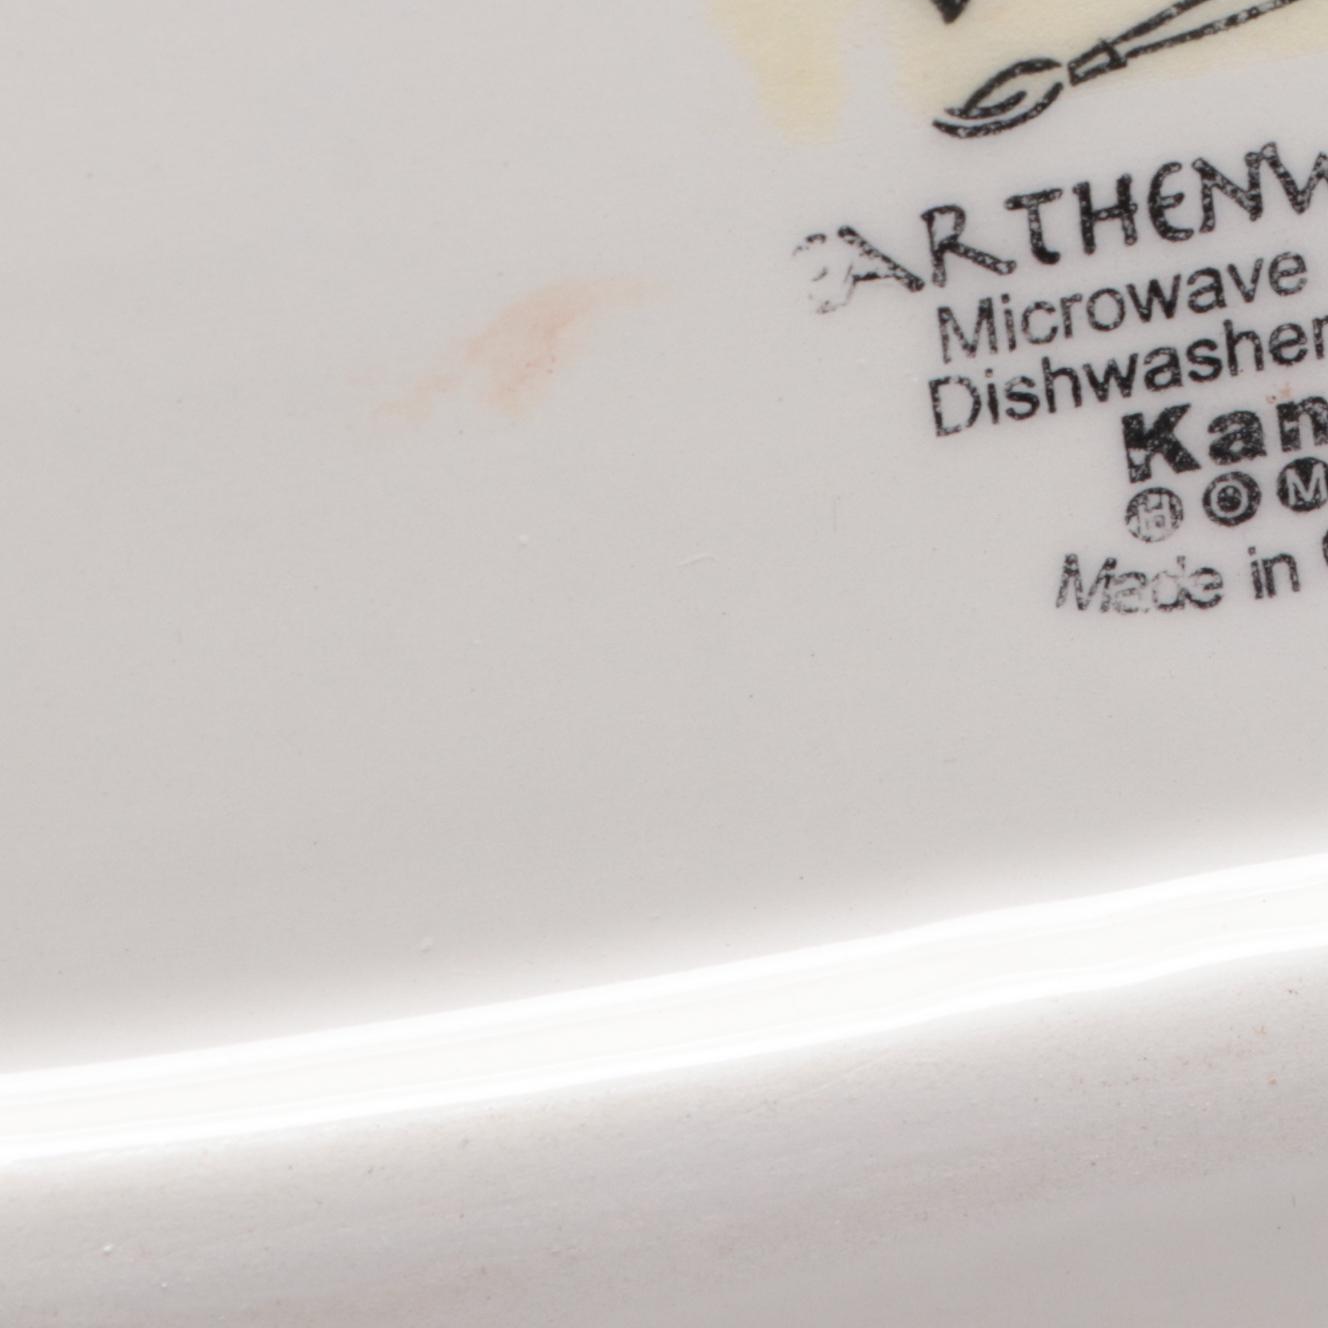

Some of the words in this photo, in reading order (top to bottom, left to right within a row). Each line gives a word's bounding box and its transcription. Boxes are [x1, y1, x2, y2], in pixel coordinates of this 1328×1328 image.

[936, 246, 1308, 364] Microwave
[1055, 552, 1225, 615] Made
[1248, 545, 1301, 601] in
